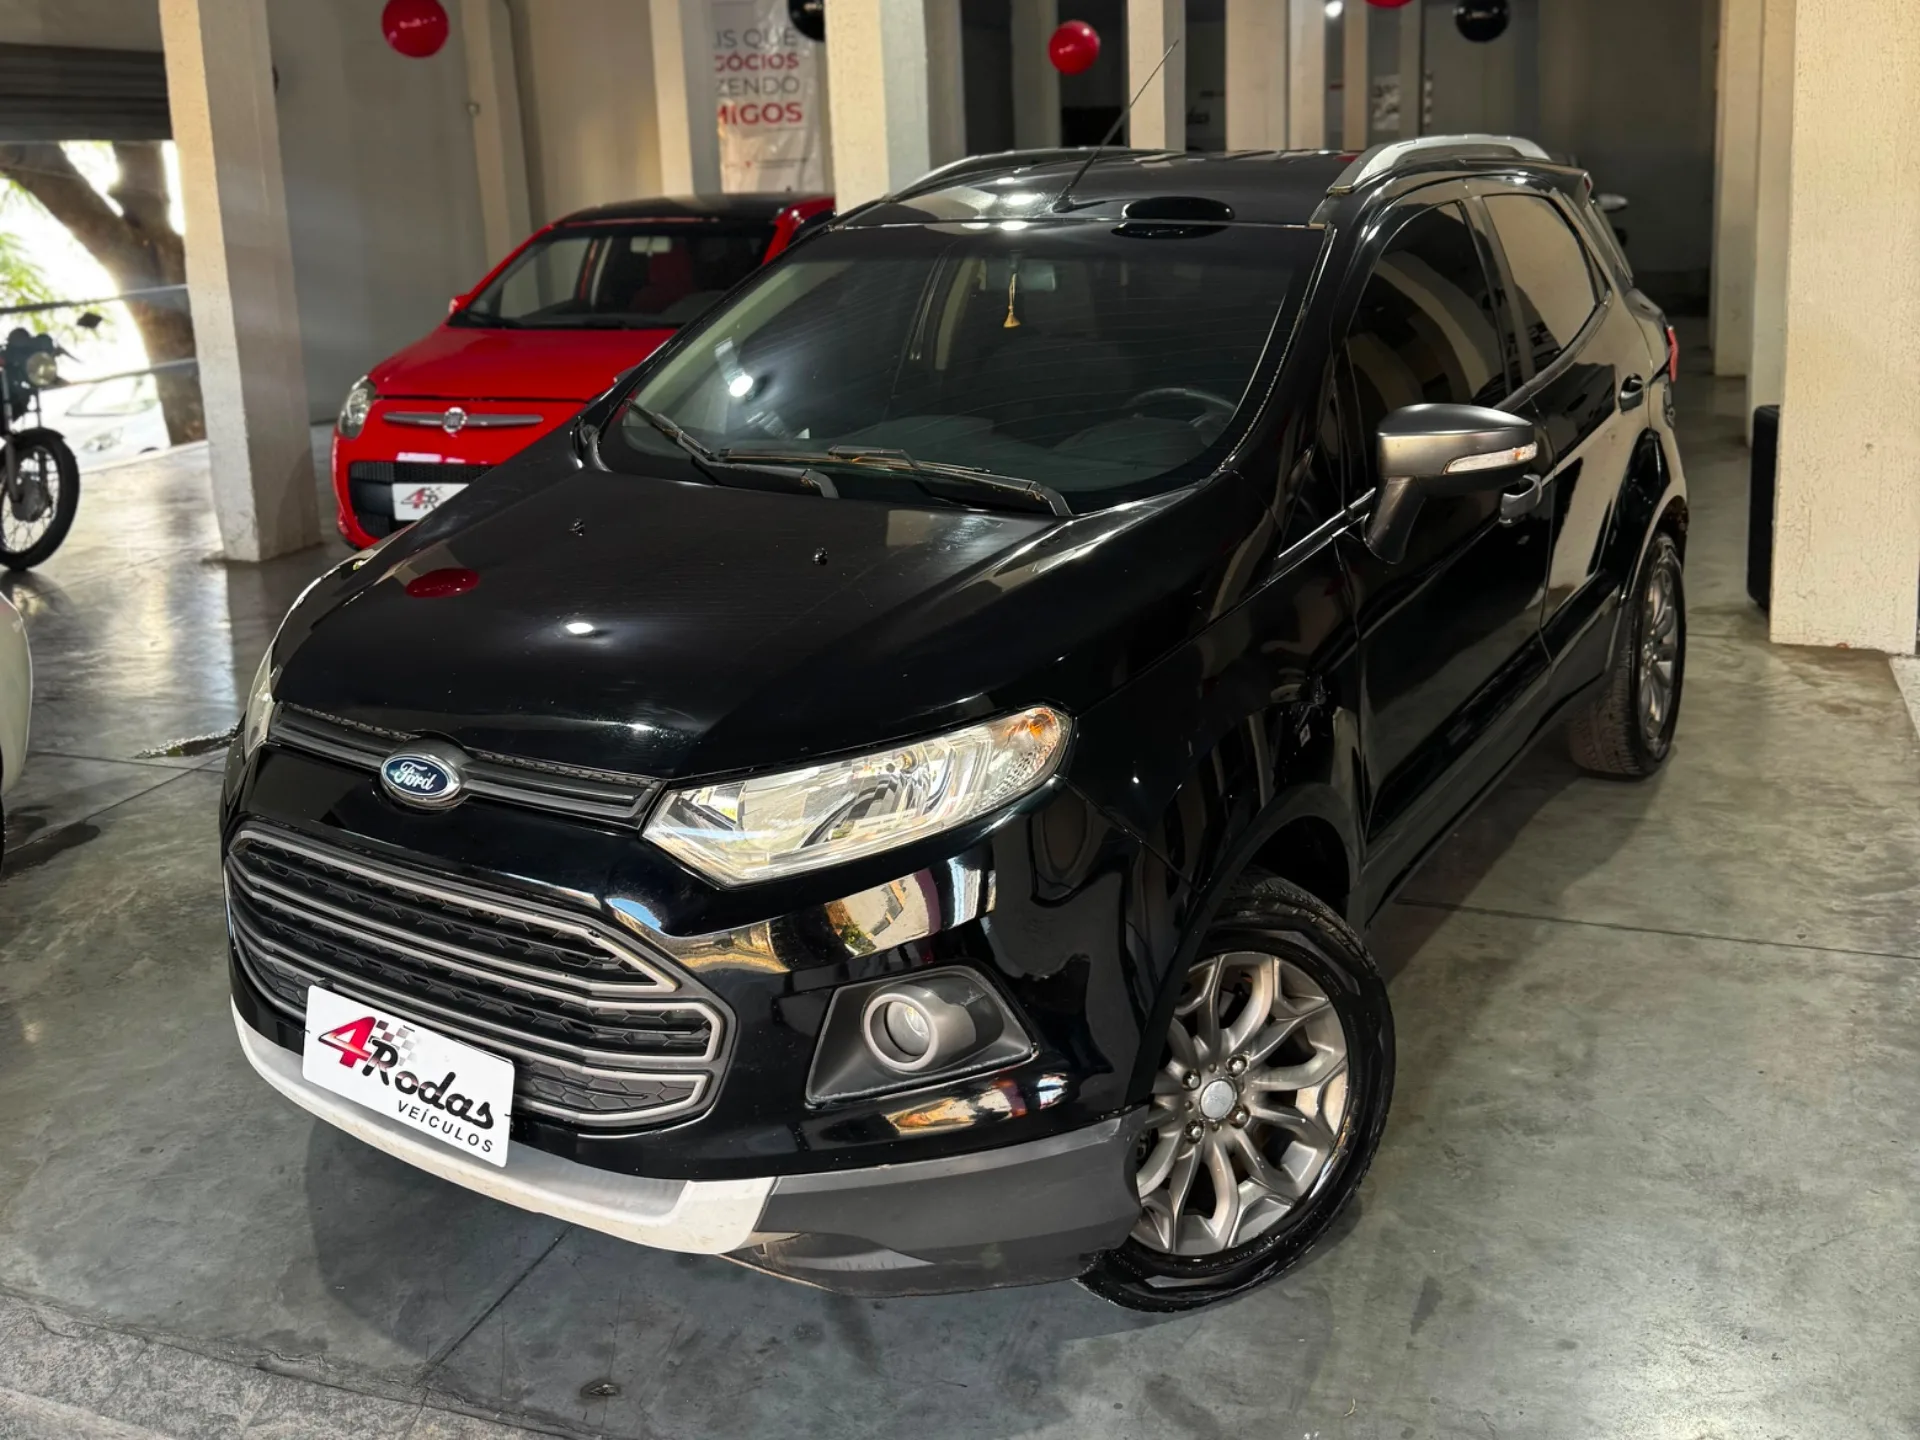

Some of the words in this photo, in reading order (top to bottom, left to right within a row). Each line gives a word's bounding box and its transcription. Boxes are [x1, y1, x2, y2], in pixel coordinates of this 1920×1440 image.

[714, 29, 737, 48] IS
[743, 27, 798, 49] QUE
[394, 761, 437, 790] Ford
[397, 1099, 494, 1153] VEÍCULOS
